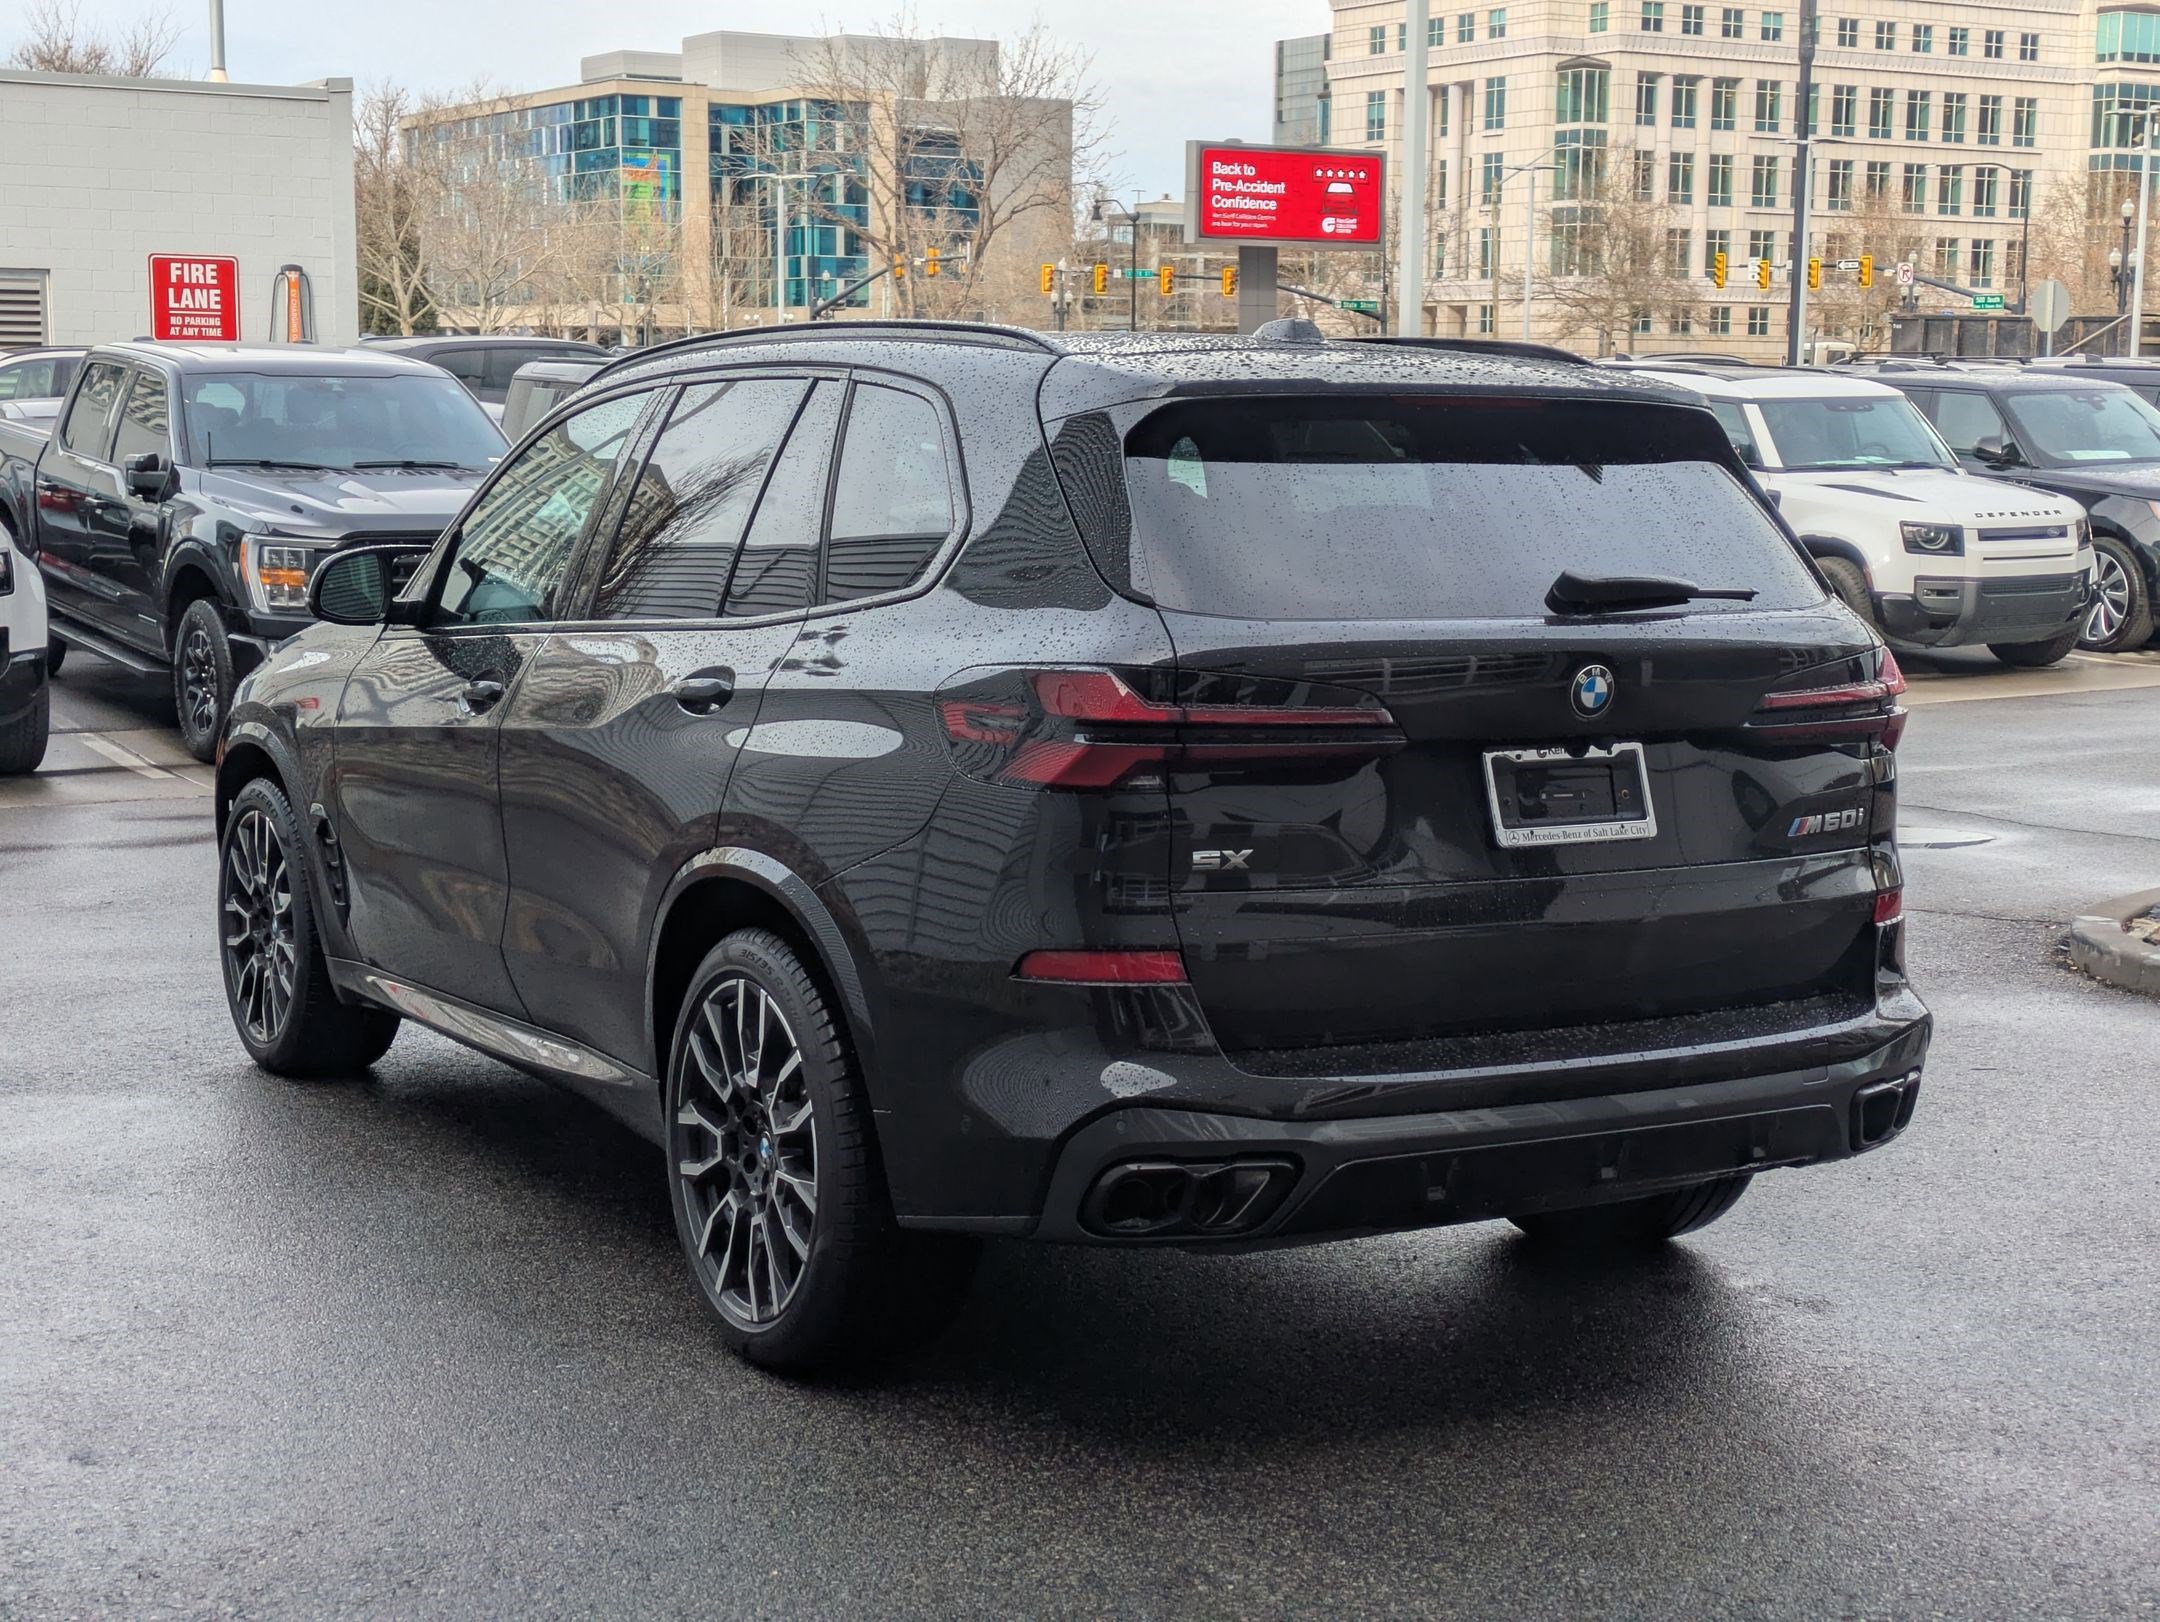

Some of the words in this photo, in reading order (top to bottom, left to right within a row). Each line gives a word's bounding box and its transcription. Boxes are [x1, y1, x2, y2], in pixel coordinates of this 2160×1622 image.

[1212, 161, 1242, 175] Back
[1243, 163, 1256, 176] to
[1212, 178, 1286, 194] Pre-Accident
[1211, 194, 1277, 210] Confidence
[170, 262, 218, 284] FIRE
[168, 287, 221, 309] LANE
[170, 316, 182, 325] NO
[184, 316, 221, 326] PARKING
[169, 326, 180, 336] AT
[182, 327, 200, 336] ANY
[201, 327, 223, 337] TIME
[1974, 509, 2062, 518] DEFENDER
[256, 790, 278, 818] ZERO
[1795, 807, 1864, 835] M60i
[1522, 829, 1581, 842] Mercedes-Benz
[1583, 828, 1591, 838] of
[1593, 827, 1608, 837] Salt
[1610, 827, 1628, 836] Lake
[1630, 826, 1647, 836] City
[739, 949, 775, 976] 315/35
